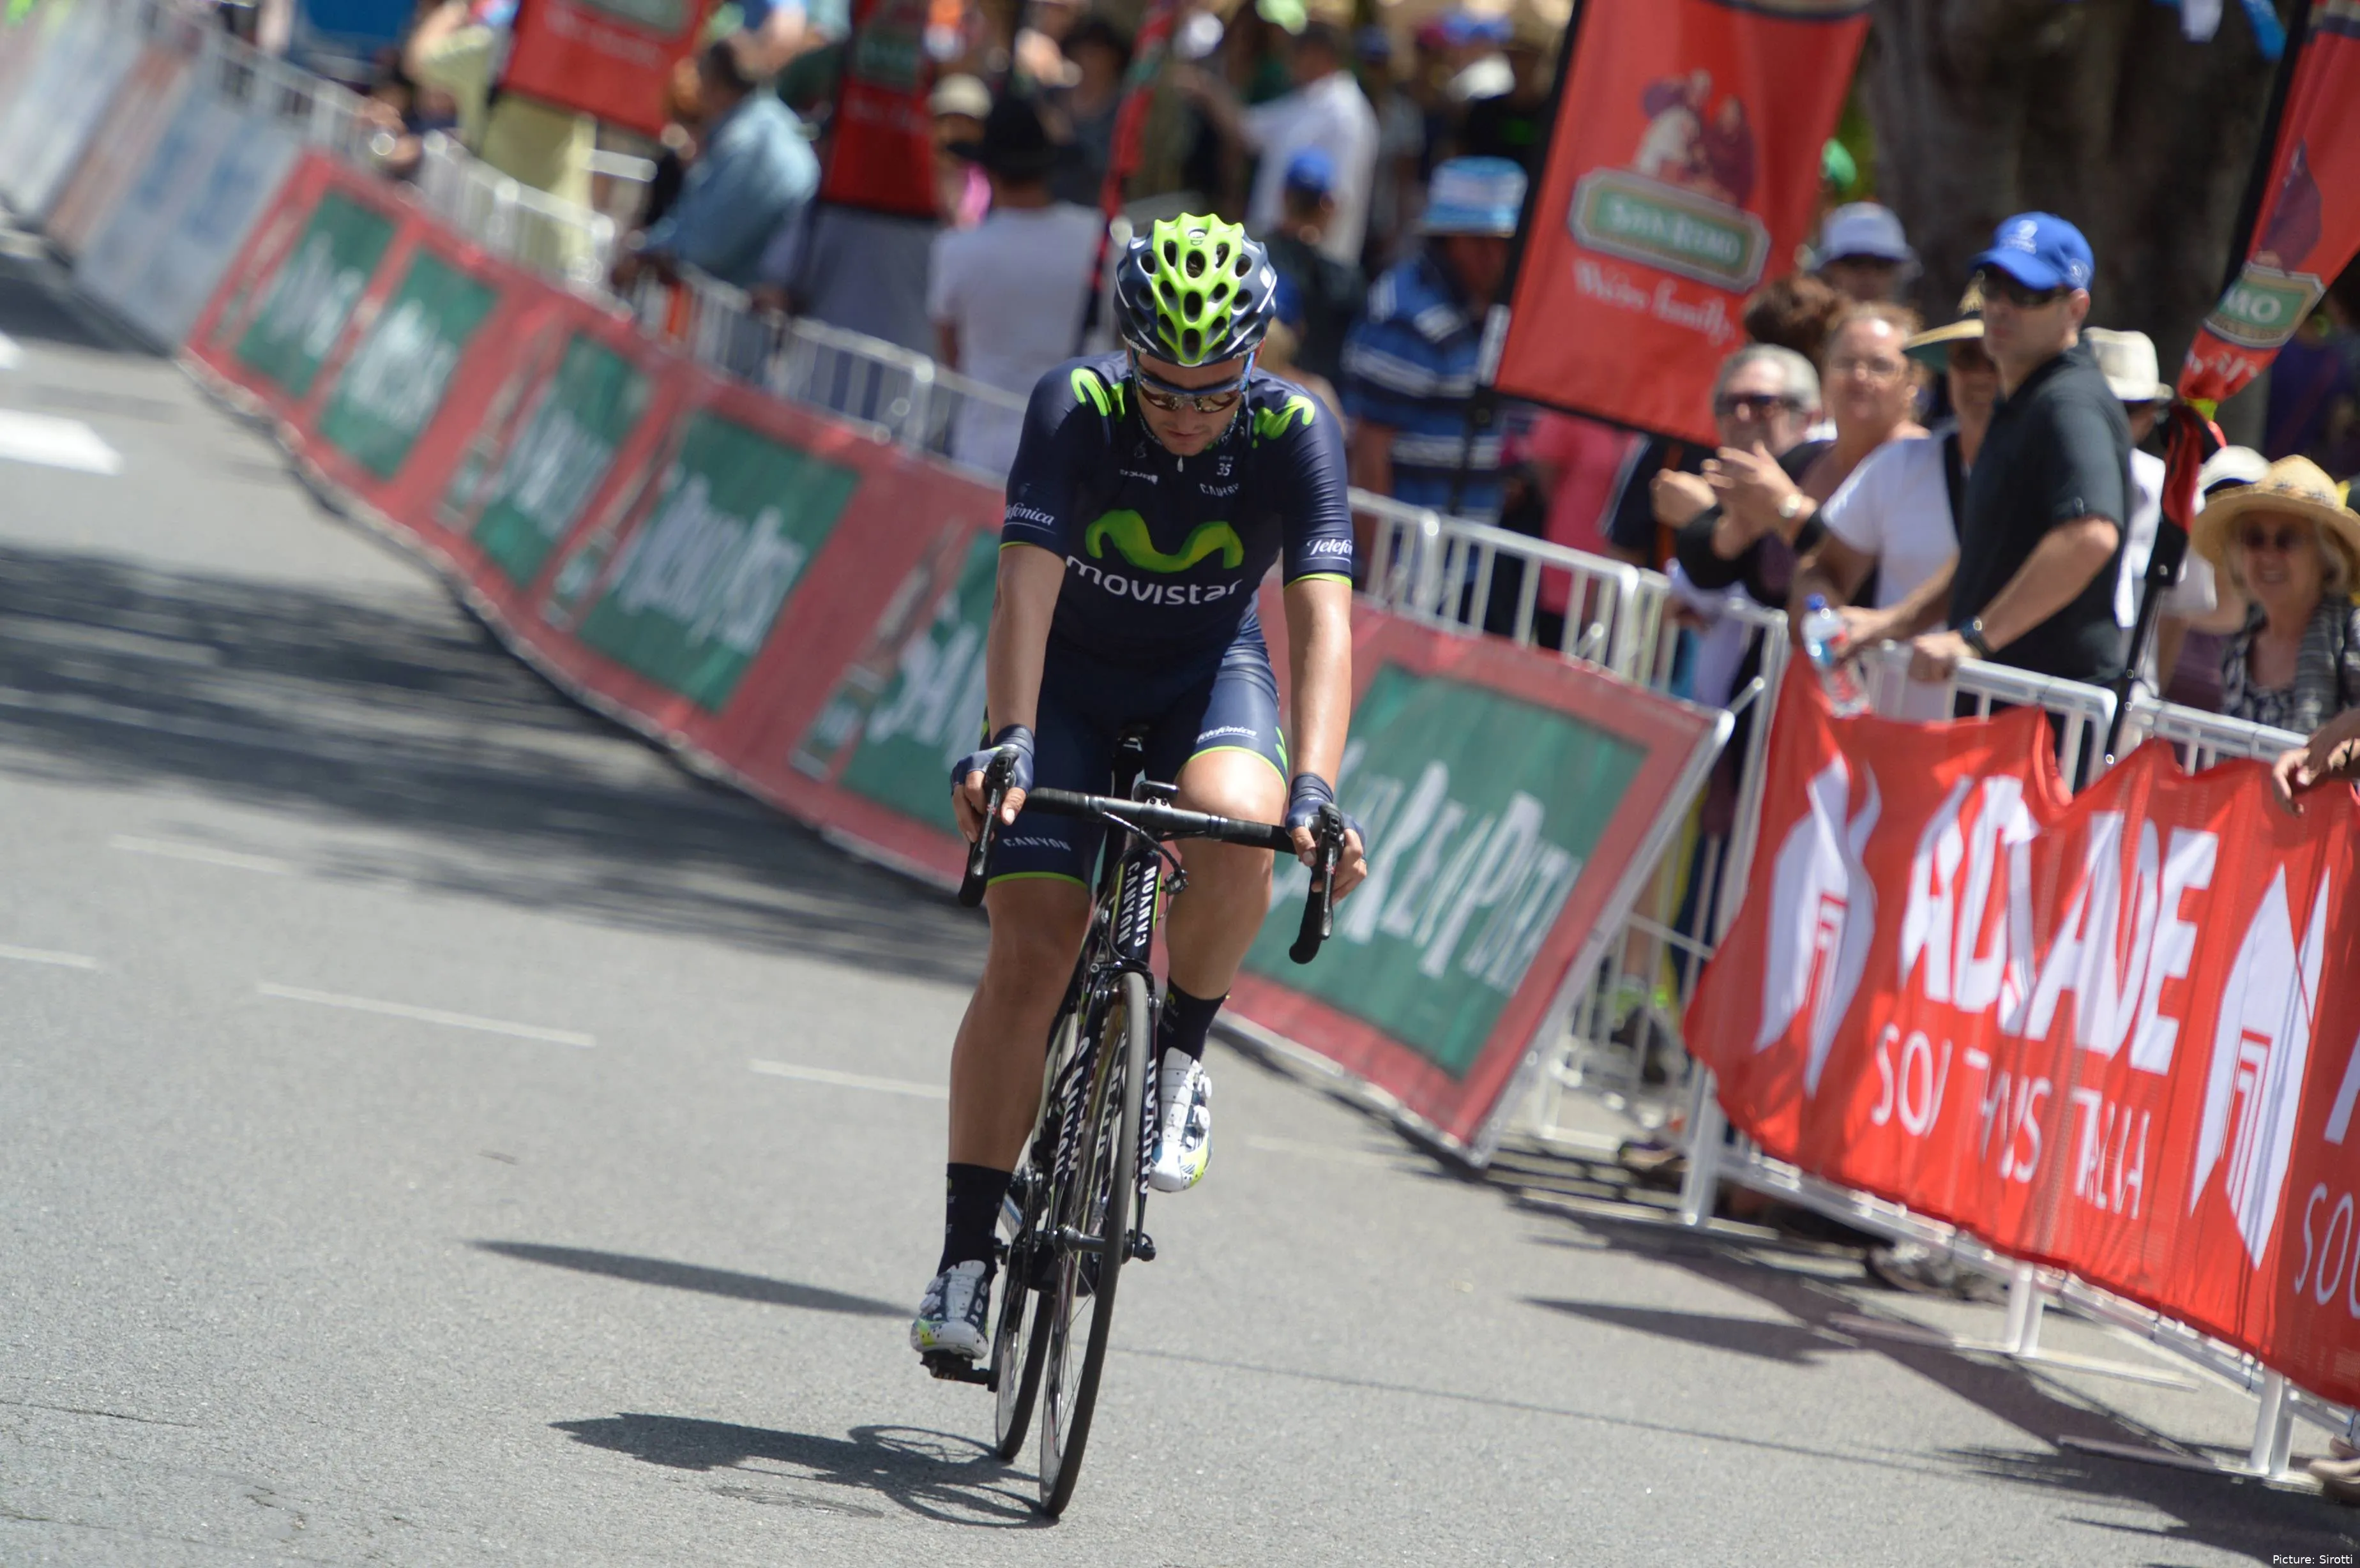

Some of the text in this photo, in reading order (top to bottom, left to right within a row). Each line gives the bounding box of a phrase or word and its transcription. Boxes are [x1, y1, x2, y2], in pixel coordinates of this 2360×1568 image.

[2225, 287, 2281, 323] MO
[1216, 463, 1232, 476] 35
[1066, 555, 1243, 605] movistar
[1002, 836, 1071, 852] CANYON
[1117, 861, 1141, 945] CANYON
[1134, 865, 1158, 947] CANYON
